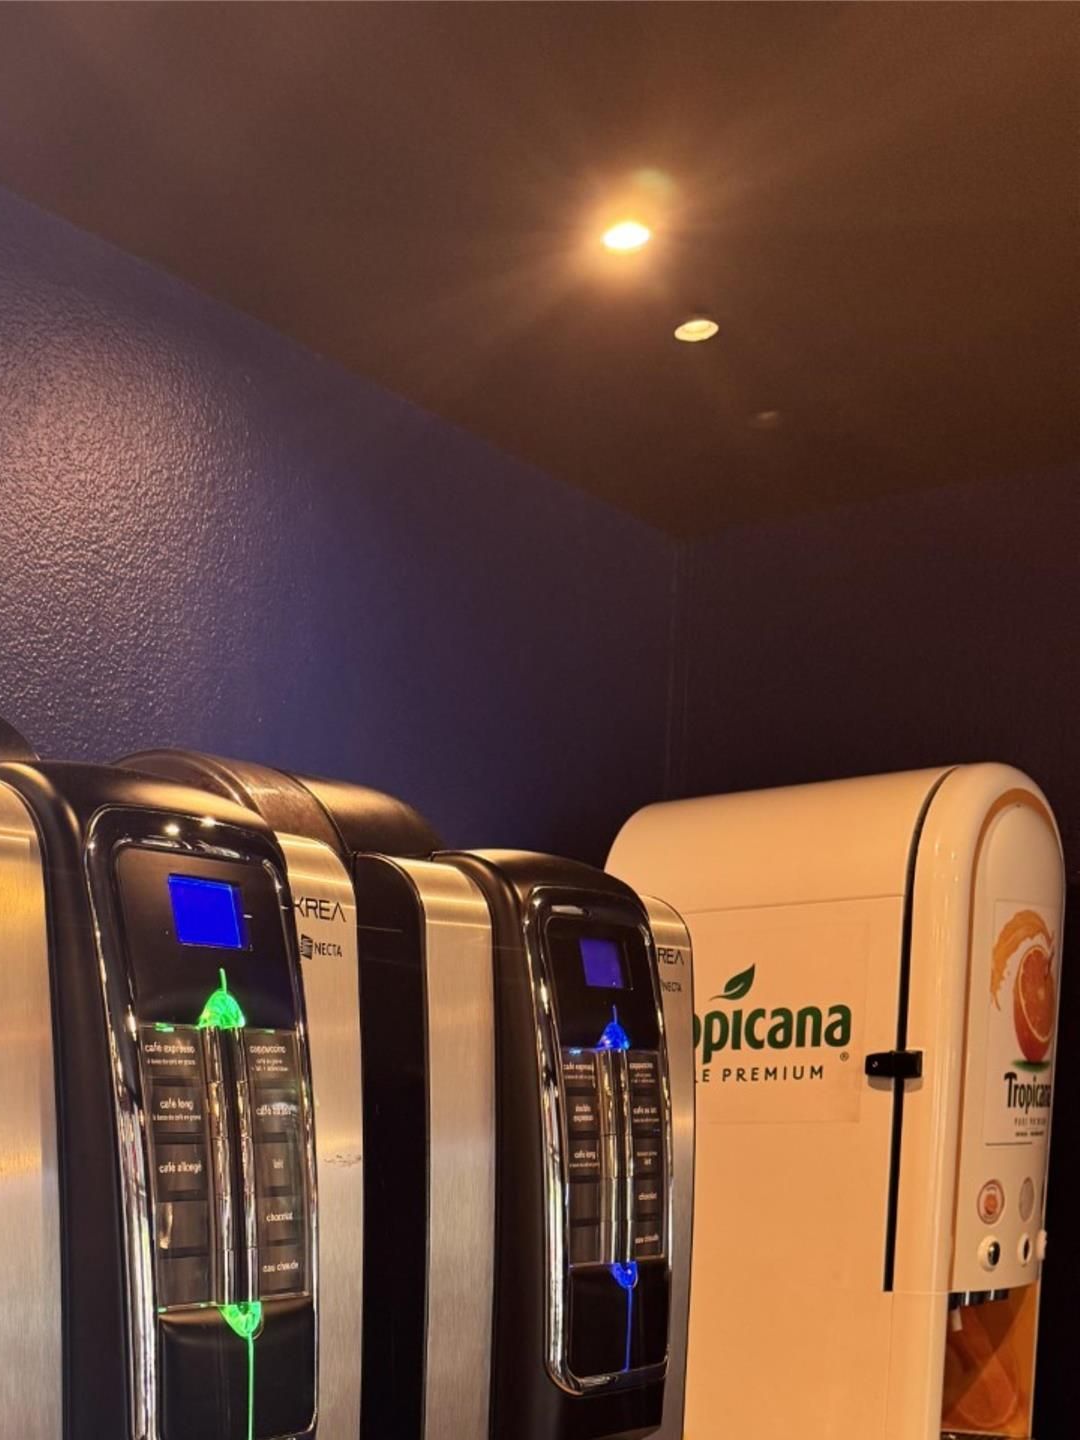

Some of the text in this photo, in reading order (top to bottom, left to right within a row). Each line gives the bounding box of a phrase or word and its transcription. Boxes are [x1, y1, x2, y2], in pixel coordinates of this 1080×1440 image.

[314, 942, 343, 957] NECTA
[657, 947, 685, 966] REA
[722, 1065, 824, 1082] PREMIUM
[160, 1097, 194, 1111] café long
[159, 1161, 176, 1174] café
